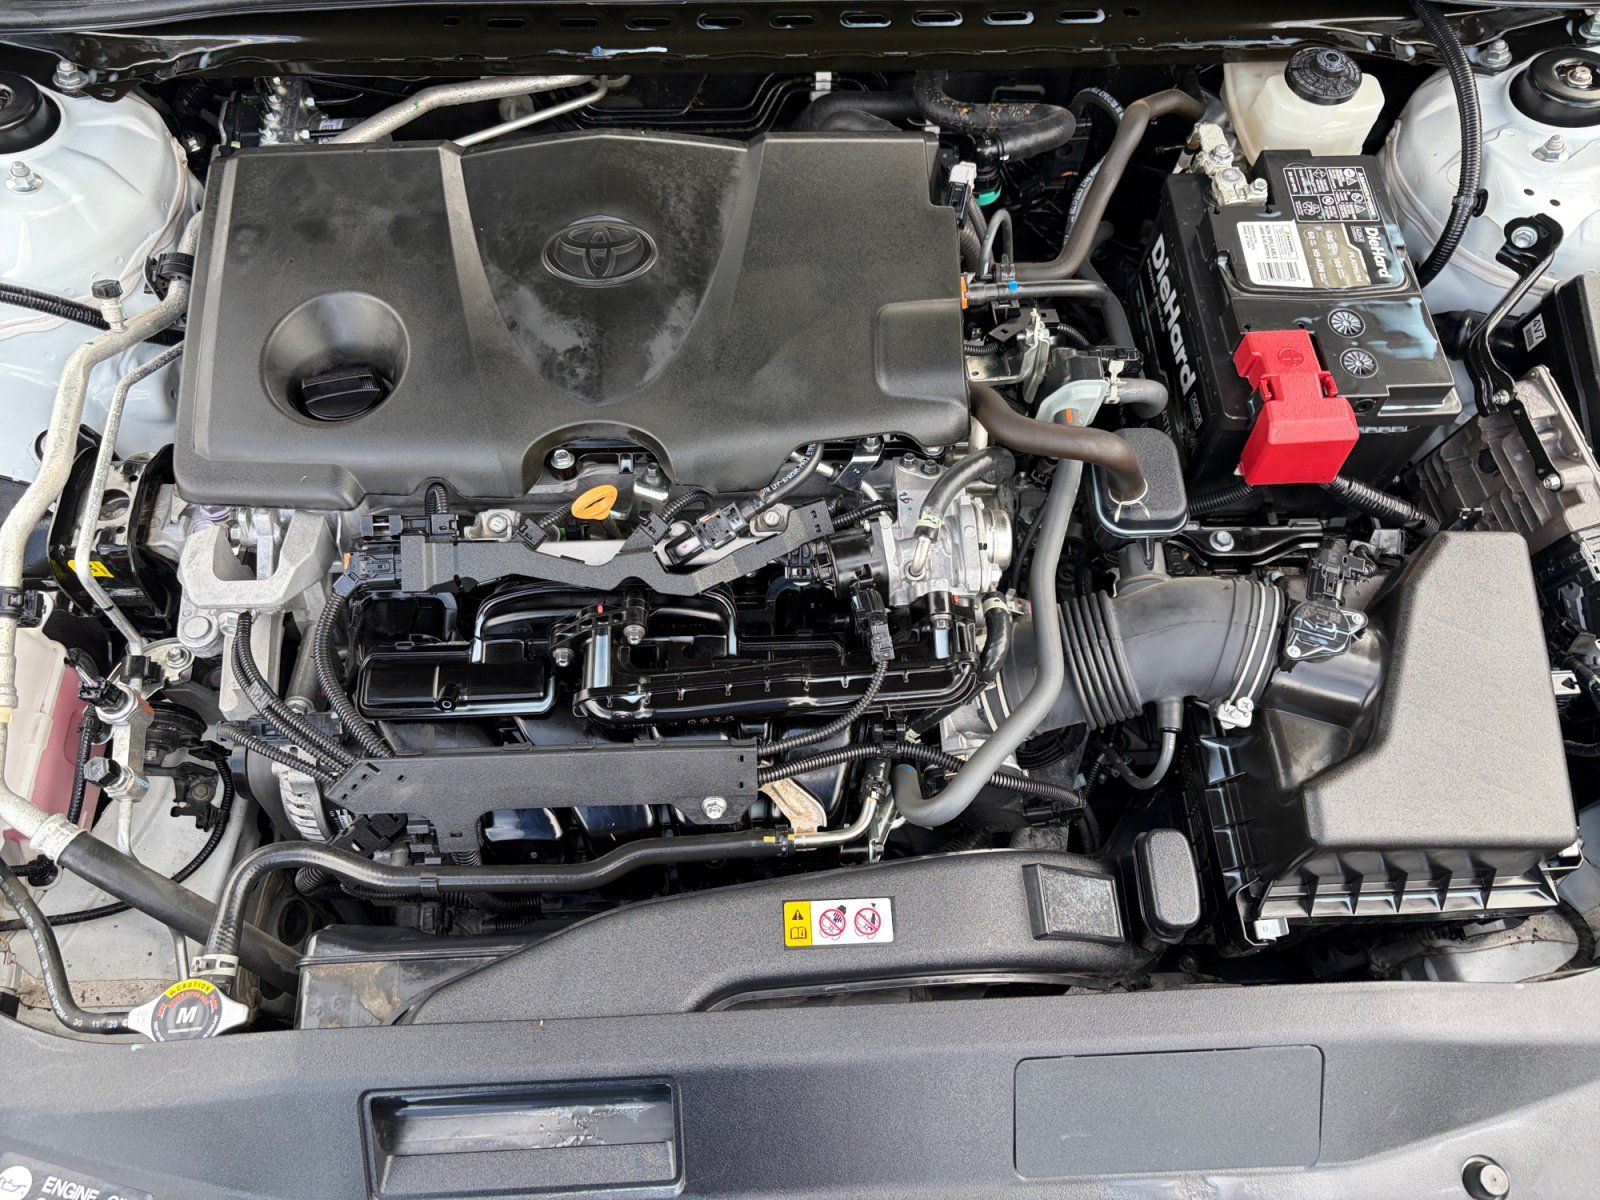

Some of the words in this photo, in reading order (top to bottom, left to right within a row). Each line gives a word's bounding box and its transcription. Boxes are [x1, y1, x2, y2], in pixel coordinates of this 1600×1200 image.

[1364, 227, 1393, 278] DieHard
[1151, 233, 1197, 396] DieHard
[176, 981, 211, 993] CAUTION
[176, 1005, 198, 1024] M
[41, 1175, 100, 1200] ENGINE
